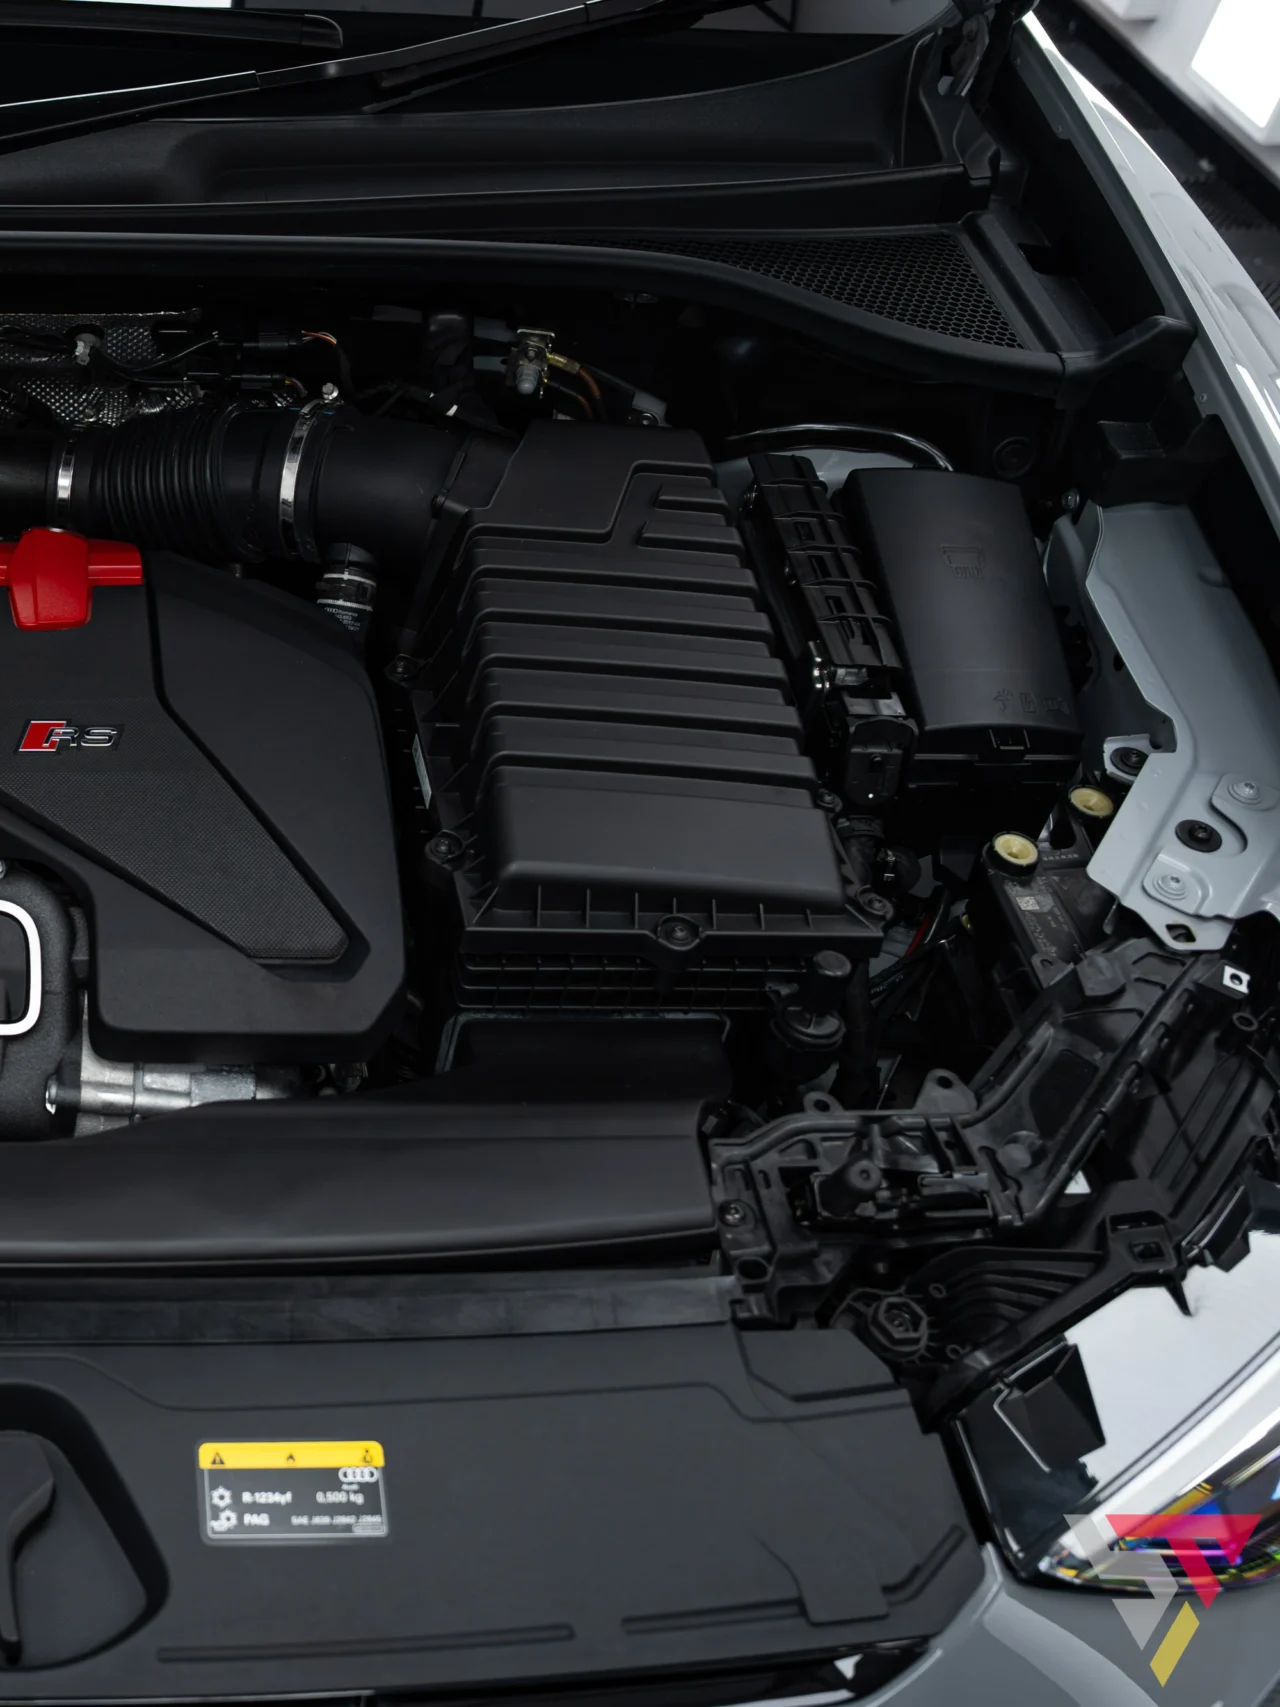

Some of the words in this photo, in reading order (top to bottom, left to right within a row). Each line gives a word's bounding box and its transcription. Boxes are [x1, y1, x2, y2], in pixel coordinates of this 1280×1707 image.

[41, 726, 118, 747] RS
[349, 1491, 364, 1505] kg
[243, 1513, 270, 1526] PAG
